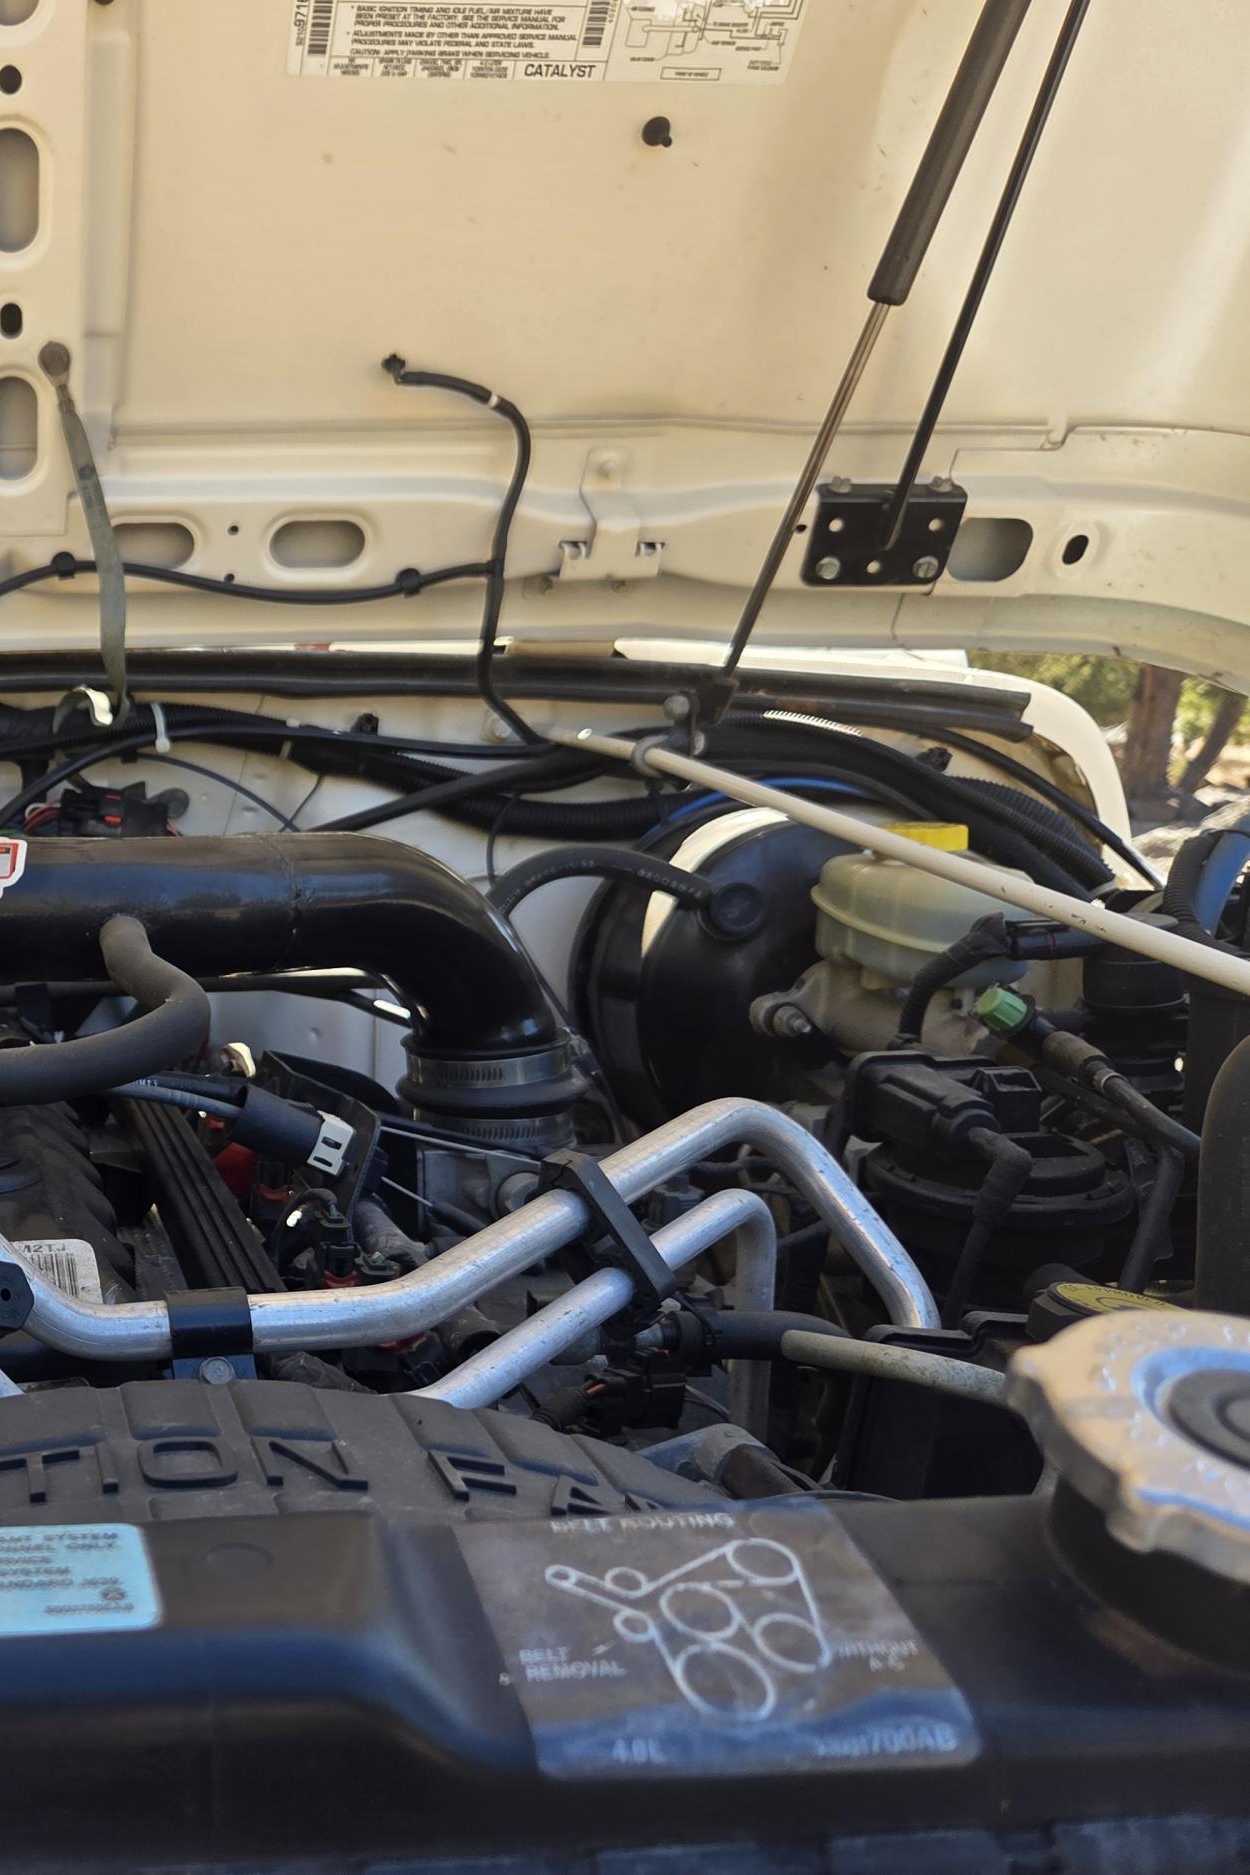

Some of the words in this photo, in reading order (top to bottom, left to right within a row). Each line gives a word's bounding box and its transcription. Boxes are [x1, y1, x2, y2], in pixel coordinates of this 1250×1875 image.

[356, 5, 377, 13] BASIC
[378, 5, 408, 14] IGNITION
[409, 6, 434, 14] TIMING
[435, 6, 451, 15] AND
[355, 12, 374, 20] BEEN
[490, 15, 519, 23] SERVICE
[383, 20, 428, 28] PROCEDURES
[446, 21, 469, 29] OTHER
[469, 22, 510, 30] ADDITIONAL
[518, 33, 547, 41] SERVICE
[443, 40, 473, 48] FEDERAL
[484, 51, 521, 59] SERVICING
[524, 63, 596, 79] CATALYST
[618, 1511, 736, 1531] ROUTING
[42, 1531, 119, 1543] SYSTEM
[519, 1646, 568, 1665] BELT
[525, 1659, 628, 1682] REMOVAL
